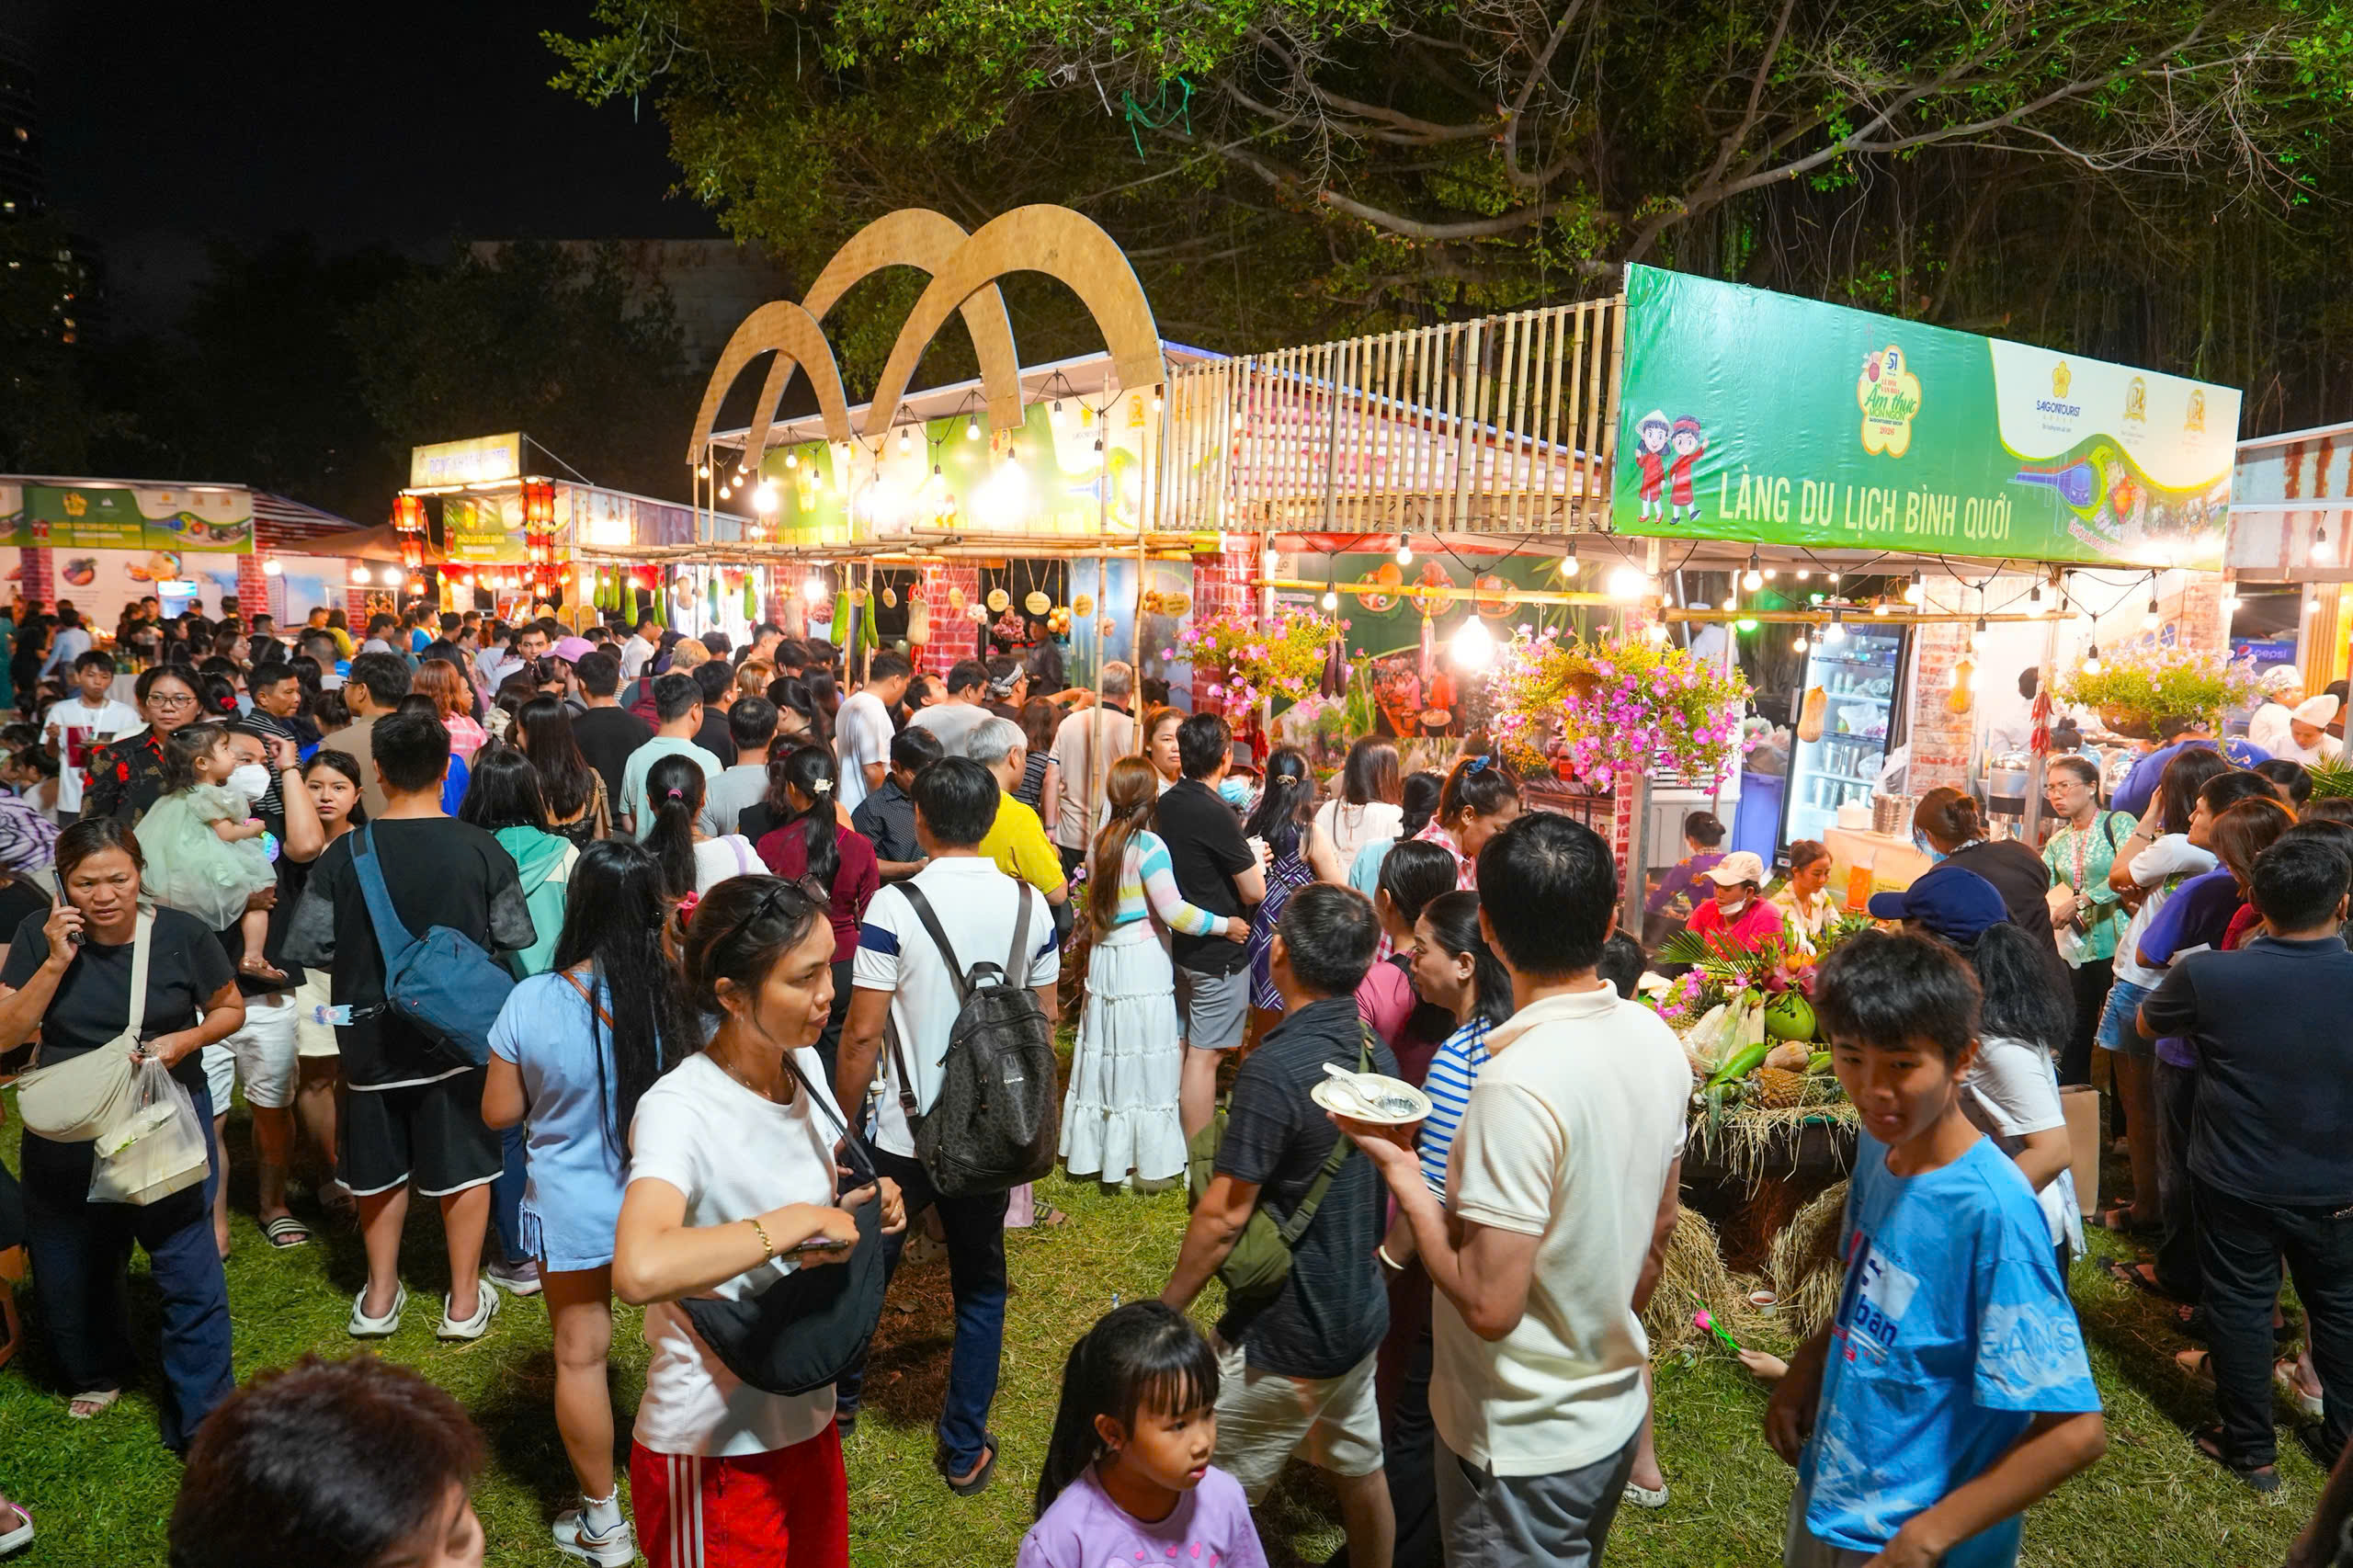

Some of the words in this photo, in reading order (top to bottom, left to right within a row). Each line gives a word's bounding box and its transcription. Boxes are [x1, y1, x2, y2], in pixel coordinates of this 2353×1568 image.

[2036, 399, 2081, 417] SAIGONTOURIST
[1719, 465, 1790, 523] LÀNG
[1800, 479, 1836, 527] DU
[1844, 485, 1898, 539] LỊCH
[1904, 483, 1958, 536] BÌNH
[1963, 492, 2013, 540] QUỚI
[2254, 648, 2288, 660] pepsi
